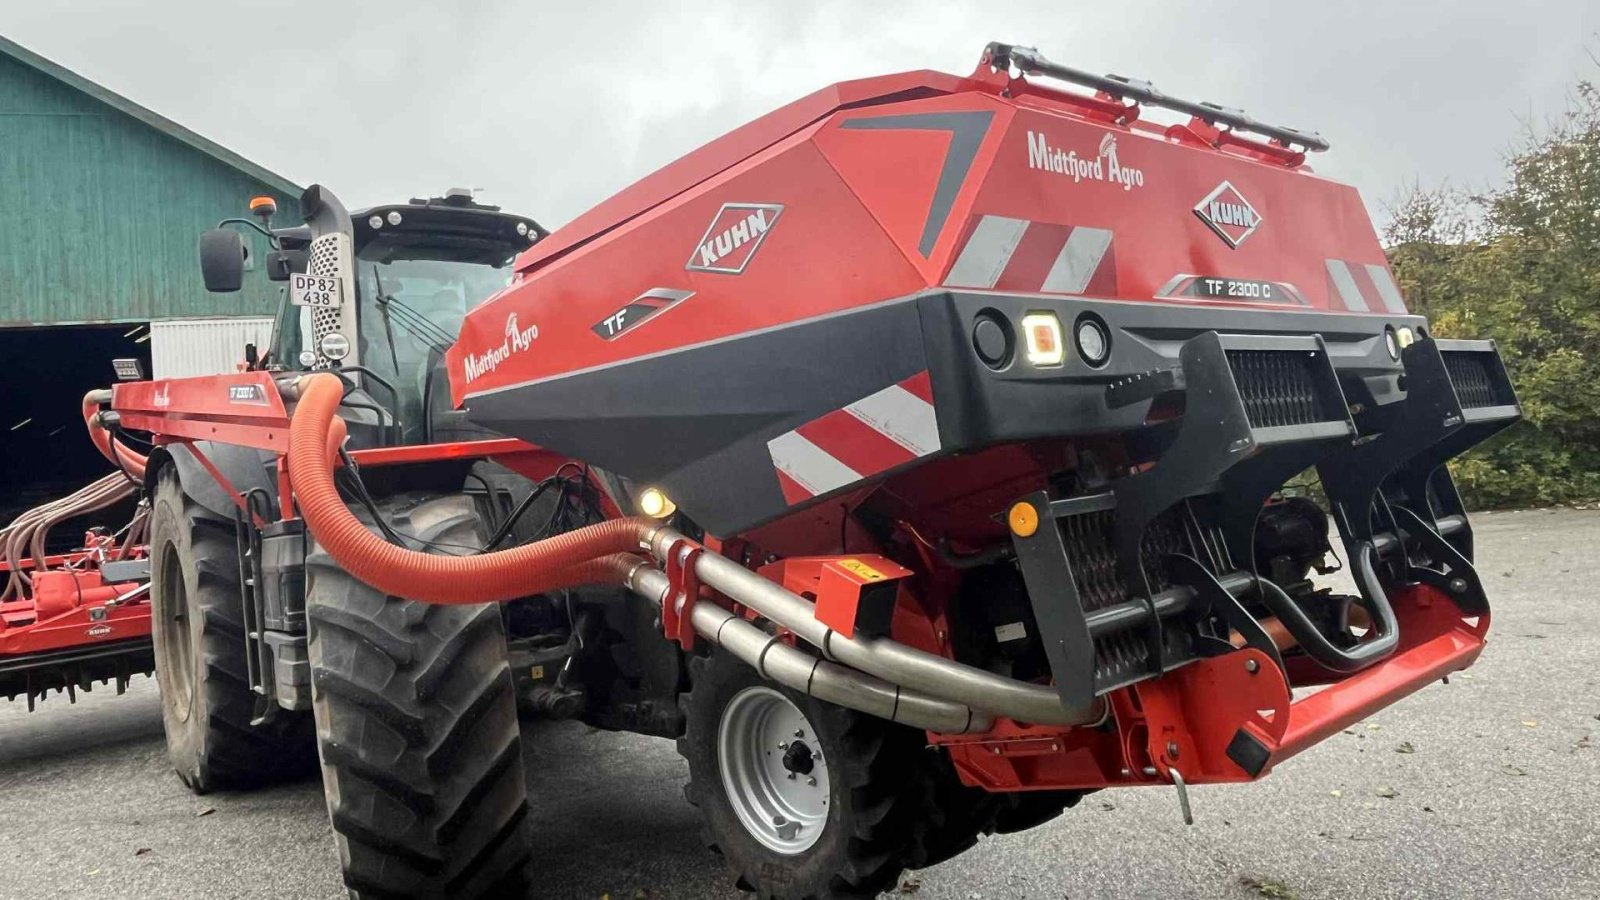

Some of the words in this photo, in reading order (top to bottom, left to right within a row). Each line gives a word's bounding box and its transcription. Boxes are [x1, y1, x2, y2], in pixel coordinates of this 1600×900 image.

[1026, 130, 1103, 184] Midtfjord
[1107, 139, 1144, 191] Agro
[1208, 200, 1256, 229] KUHN
[701, 208, 769, 267] KUHN
[303, 291, 330, 306] 438
[1205, 279, 1224, 295] TF
[1227, 281, 1260, 298] 2300
[1263, 284, 1271, 298] C
[603, 308, 627, 336] TF
[463, 337, 510, 384] Midtfjord
[506, 316, 539, 353] Agro
